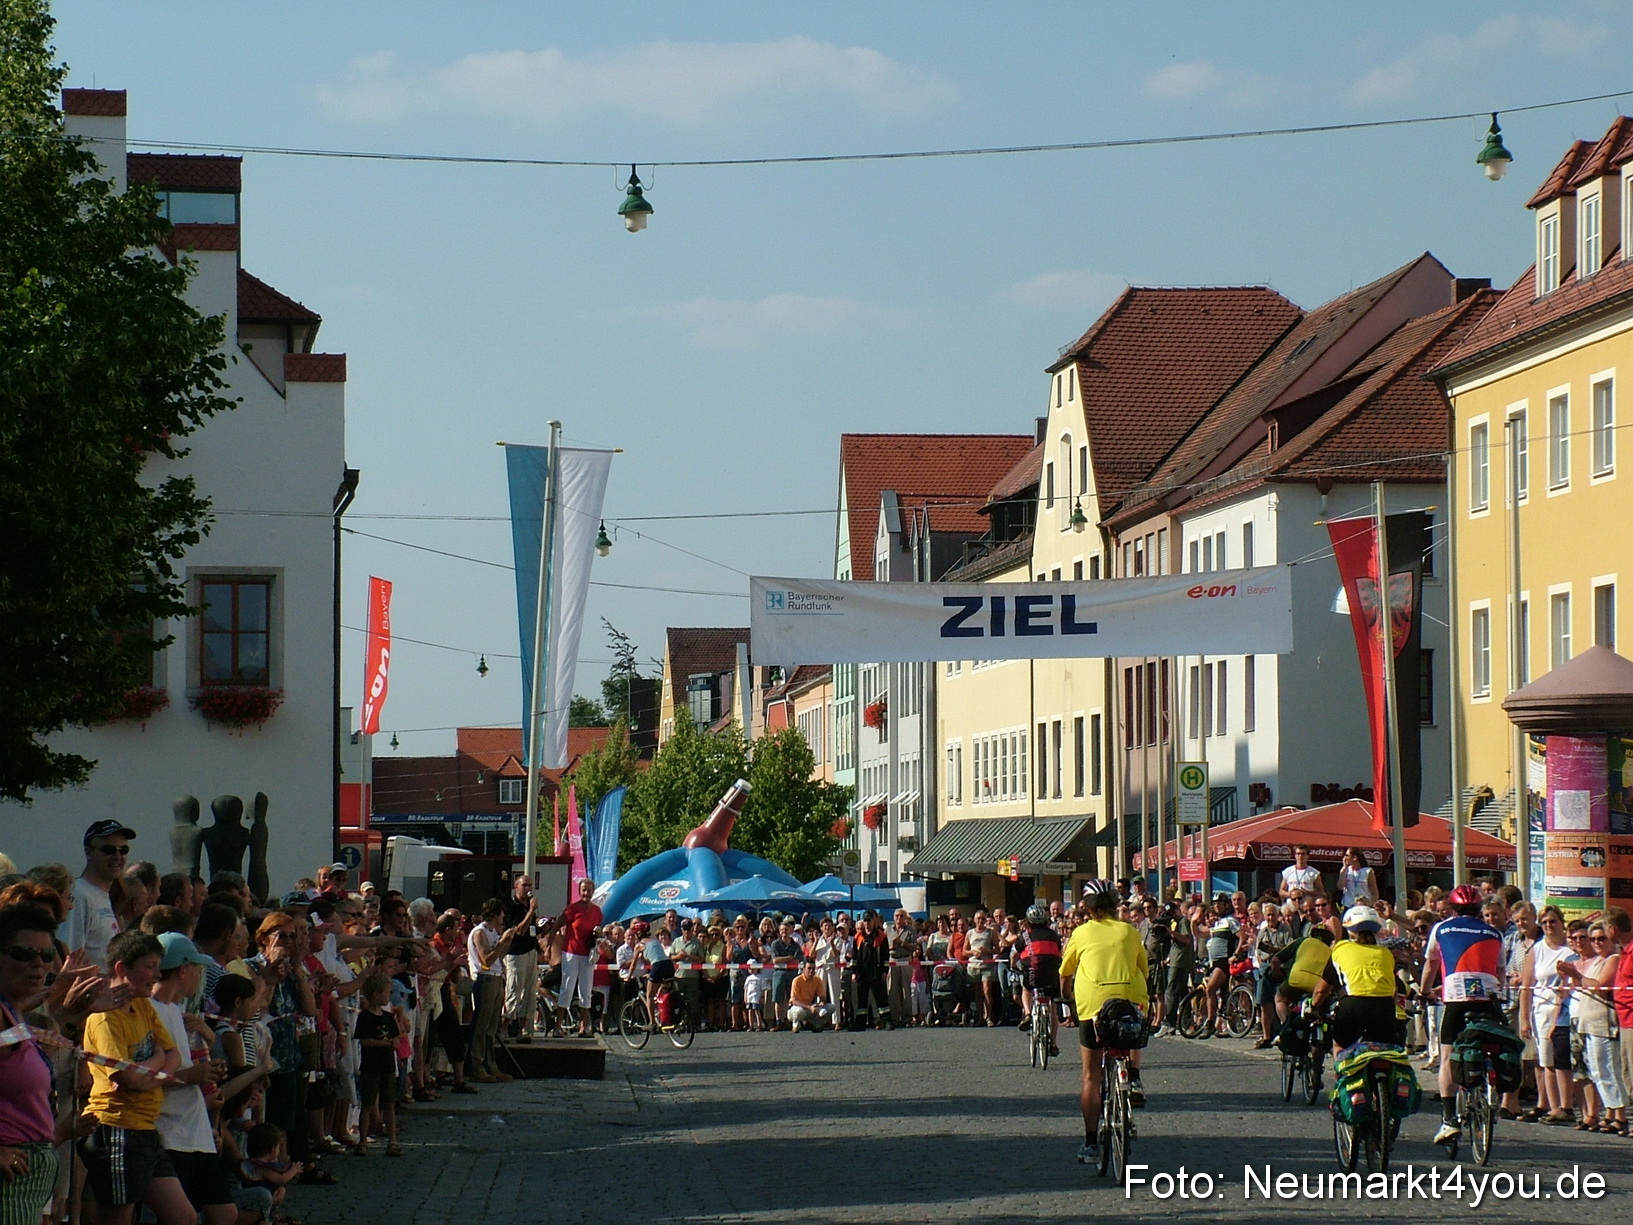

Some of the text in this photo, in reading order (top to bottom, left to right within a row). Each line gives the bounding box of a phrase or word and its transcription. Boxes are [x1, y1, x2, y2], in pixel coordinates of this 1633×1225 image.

[1247, 586, 1278, 595] Bayern
[788, 591, 844, 602] Bayerischer
[788, 601, 832, 610] Rundfunk
[940, 594, 1098, 638] ZIEL
[1309, 848, 1344, 857] adtcafé
